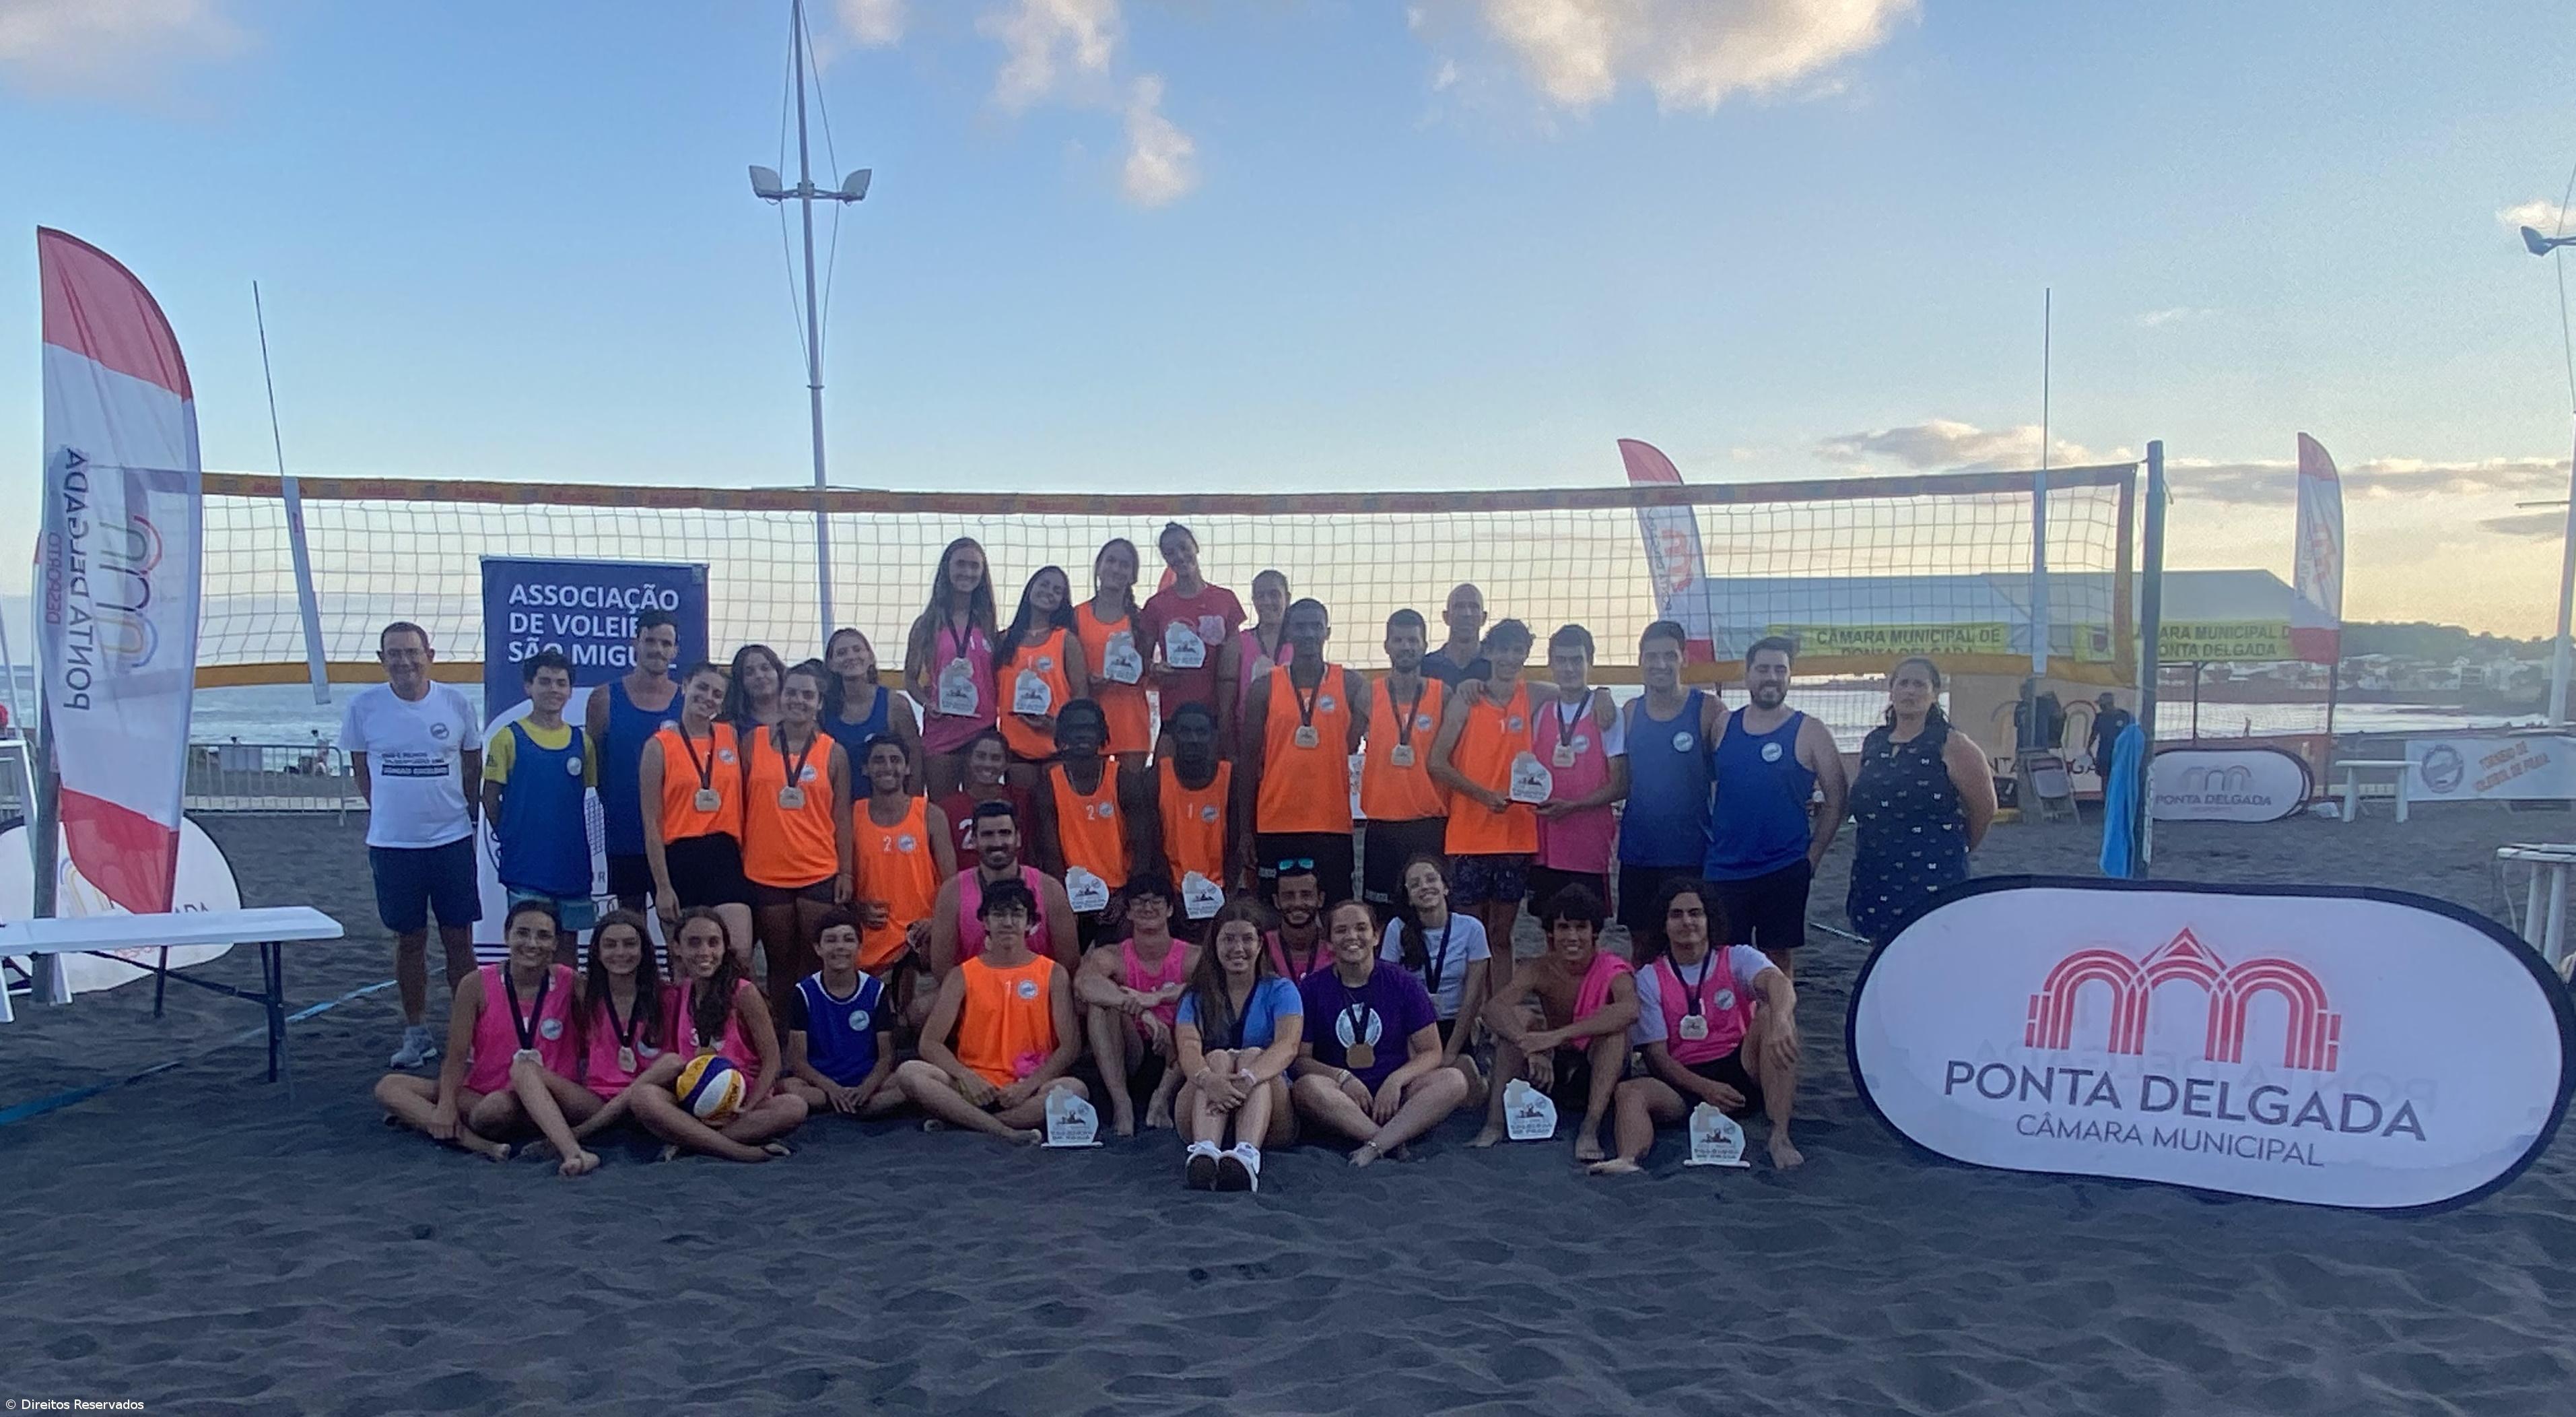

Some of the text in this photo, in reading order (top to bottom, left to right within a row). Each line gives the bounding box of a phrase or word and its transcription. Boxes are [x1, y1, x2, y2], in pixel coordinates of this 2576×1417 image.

[508, 583, 679, 614] ASSOCIAÇÃO
[509, 612, 639, 638] DE VOLEI
[2195, 626, 2277, 640] MUNICIPAL
[1979, 628, 2001, 642] DE
[2159, 642, 2277, 658] ONTA DELGADA
[2204, 794, 2272, 806] DELGADA
[1085, 804, 1095, 820] 2
[883, 834, 891, 852] 2
[1944, 1060, 2427, 1142] PONTA DELGADA
[2016, 1111, 2325, 1168] CÂMARA MUNICIPAL
